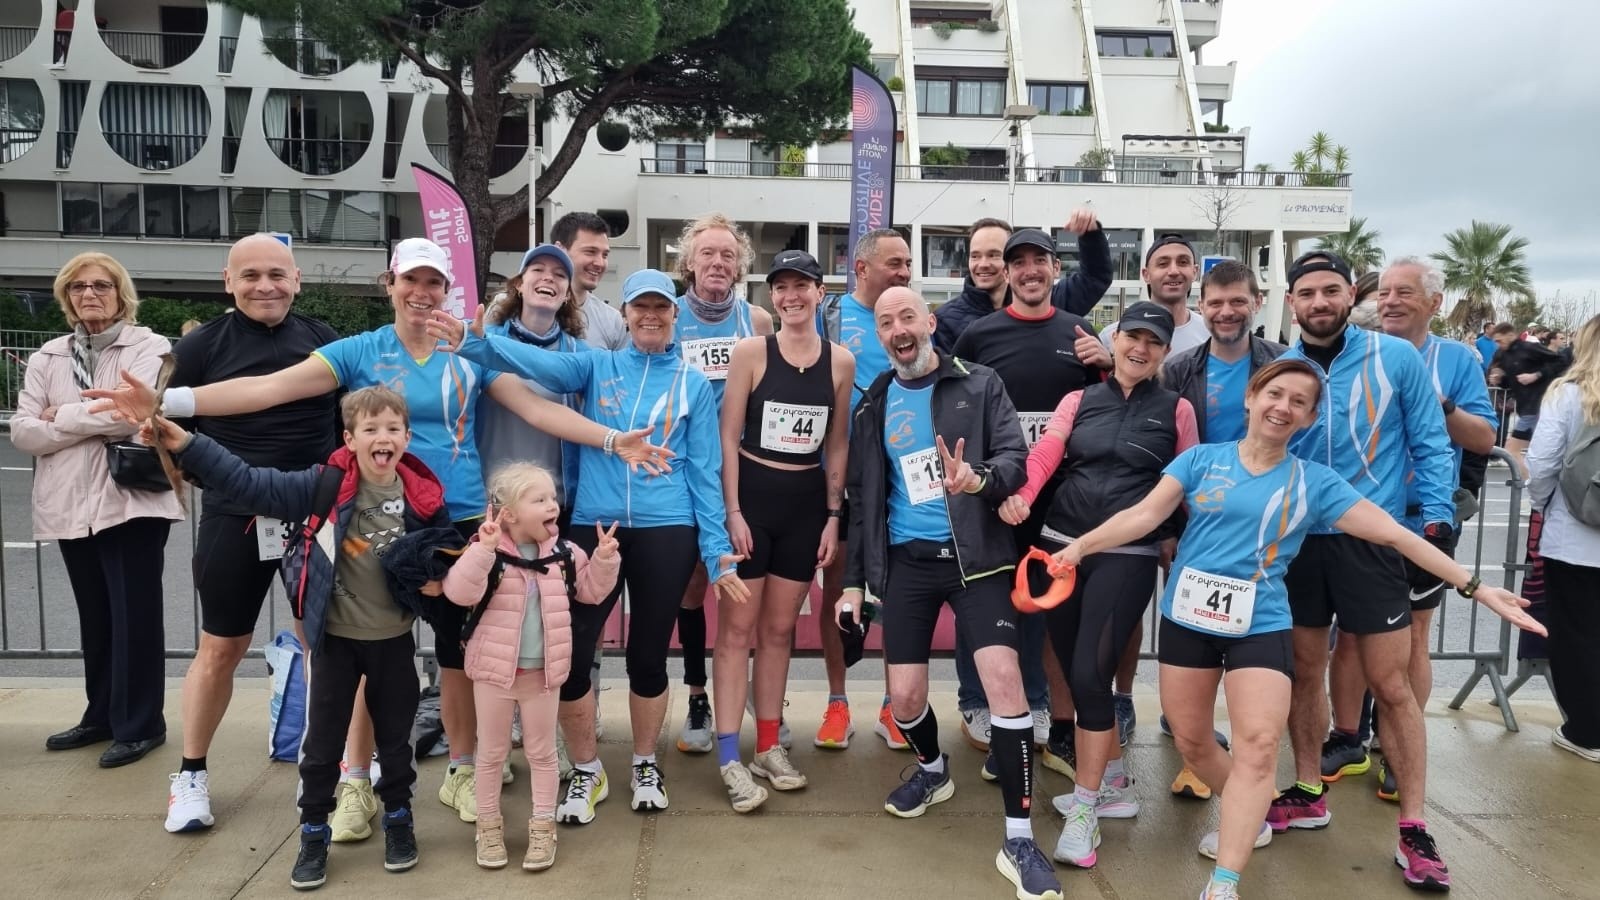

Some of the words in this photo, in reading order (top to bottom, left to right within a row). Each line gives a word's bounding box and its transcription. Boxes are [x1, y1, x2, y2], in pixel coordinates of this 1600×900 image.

[1294, 203, 1345, 213] PROVENCE
[701, 348, 730, 366] 155
[792, 418, 813, 437] 44
[1206, 589, 1233, 615] 41
